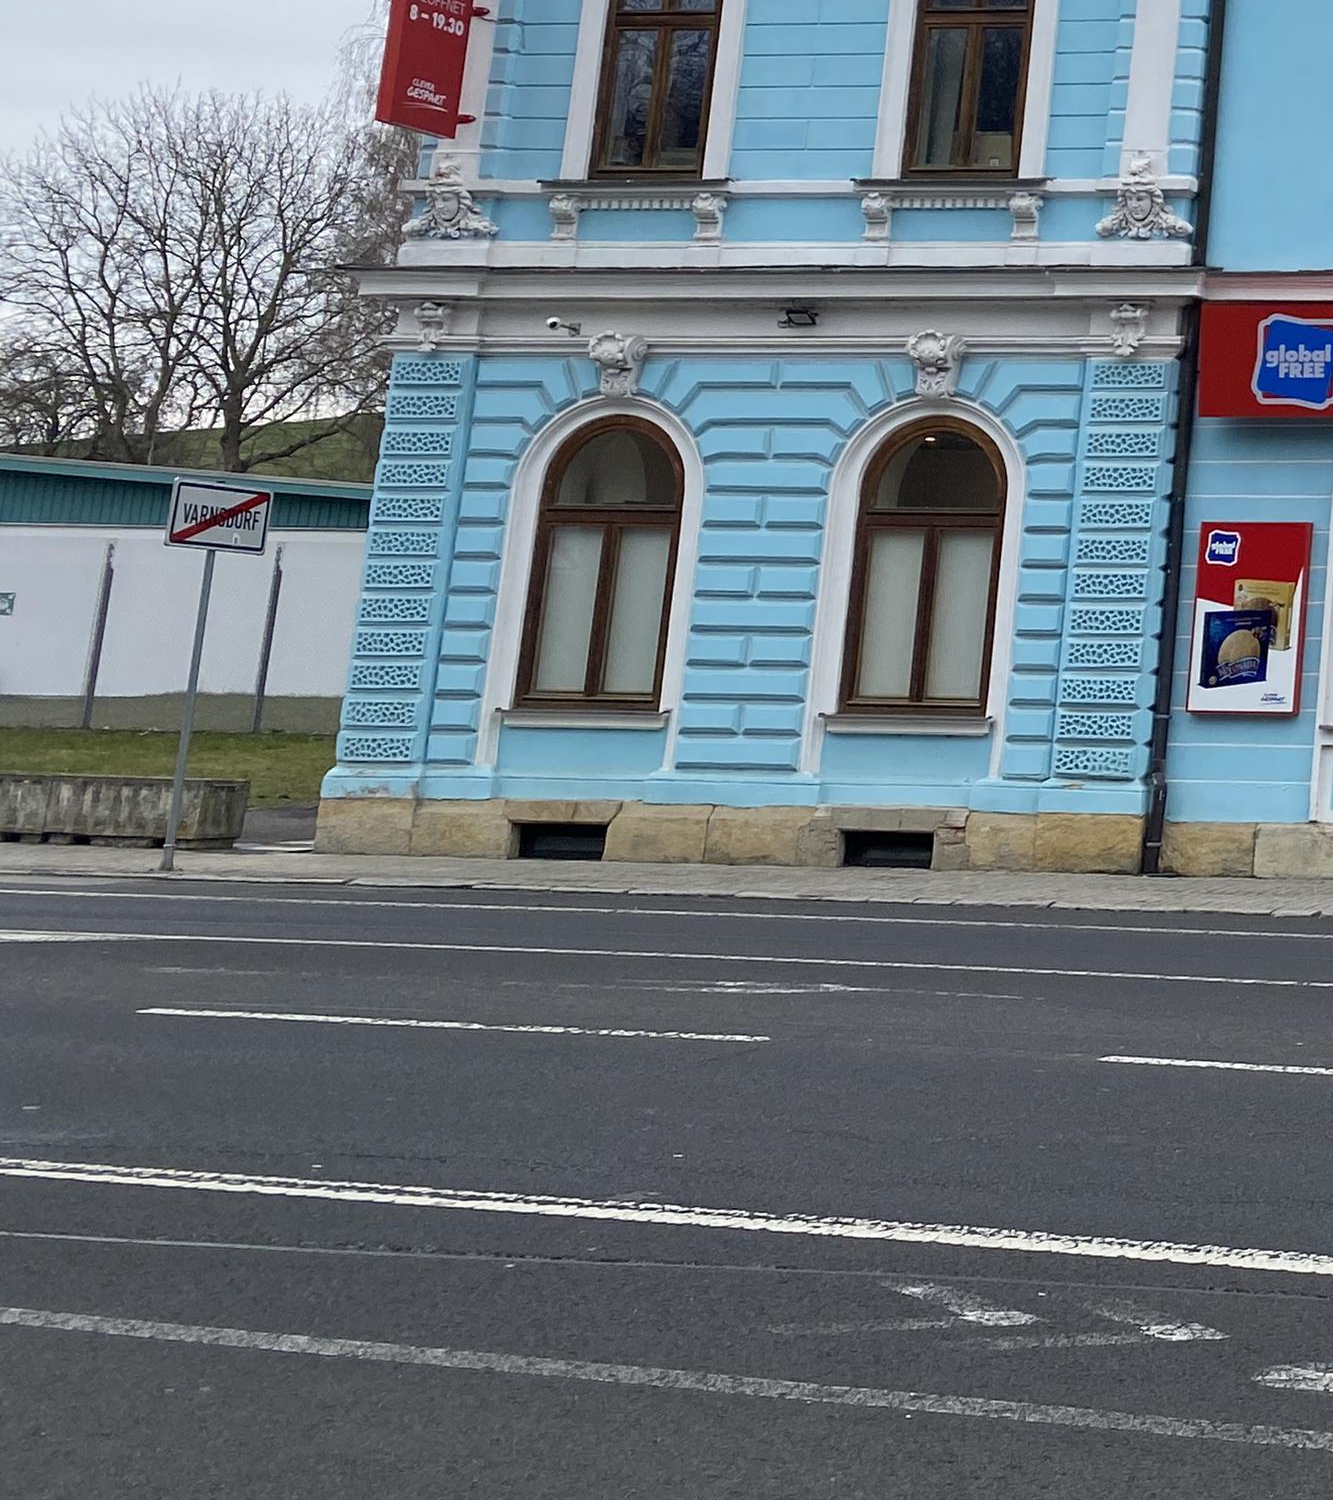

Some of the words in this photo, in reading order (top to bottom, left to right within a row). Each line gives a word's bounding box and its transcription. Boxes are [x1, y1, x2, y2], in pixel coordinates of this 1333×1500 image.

[409, 4, 418, 20] 8
[432, 12, 464, 36] 19.30
[1265, 344, 1332, 367] global
[1278, 362, 1325, 378] FREE
[183, 503, 261, 531] VARNSDORF
